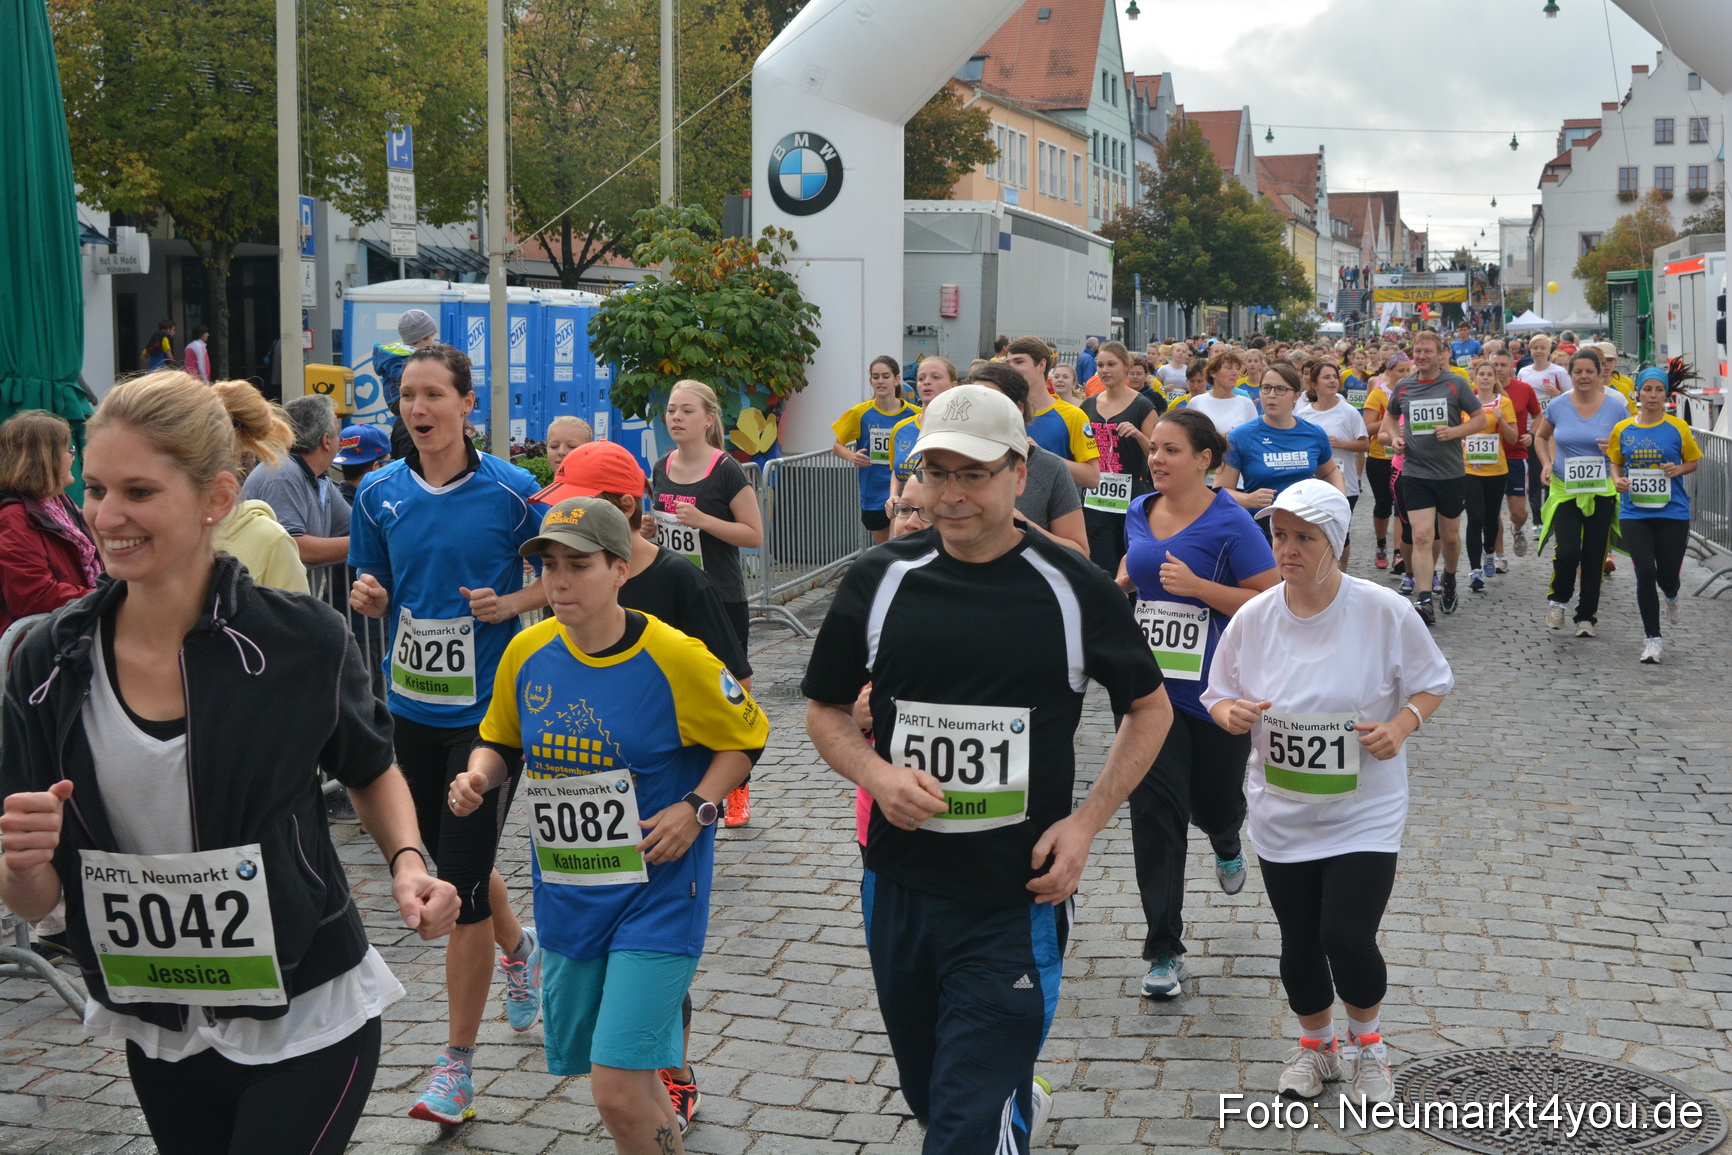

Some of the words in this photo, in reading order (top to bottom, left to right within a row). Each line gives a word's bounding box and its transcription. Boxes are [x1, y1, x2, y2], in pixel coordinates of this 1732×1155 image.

[773, 133, 837, 161] BMW
[390, 182, 413, 193] Parkschein
[393, 193, 412, 202] werktags
[99, 256, 111, 265] Hut
[120, 256, 137, 265] Mode
[335, 280, 343, 298] 3
[1404, 291, 1436, 299] START
[1349, 393, 1366, 402] 5503
[1413, 406, 1444, 421] 5019
[1468, 441, 1495, 452] 5131
[1263, 451, 1308, 462] HUBER
[1569, 465, 1602, 479] 5027
[1632, 479, 1666, 493] 5538
[658, 494, 674, 502] WIR
[676, 495, 696, 505] SIND
[657, 524, 695, 552] 5168
[1136, 608, 1157, 616] PARTL
[1158, 609, 1195, 619] Neumarkt
[411, 627, 455, 636] Neumarkt
[1139, 619, 1199, 650] 5509
[398, 631, 465, 673] 5026
[405, 675, 449, 692] Kristina
[529, 694, 545, 702] Jahre
[898, 713, 935, 728] PARTL
[938, 718, 1004, 731] Neumarkt
[1263, 715, 1289, 730] PARTL
[1291, 722, 1340, 731] Neumarkt
[1270, 731, 1344, 769] 5521
[904, 734, 1010, 785] 5031
[535, 762, 591, 775] 21.September
[526, 787, 556, 796] ARTL
[557, 785, 612, 796] Neumarkt
[948, 797, 987, 815] land
[534, 799, 629, 842] 5082
[553, 853, 621, 870] Katharina
[84, 866, 138, 884] PARTL
[142, 868, 229, 884] Neumarkt
[103, 890, 255, 949] 5042
[147, 963, 231, 985] Jessica
